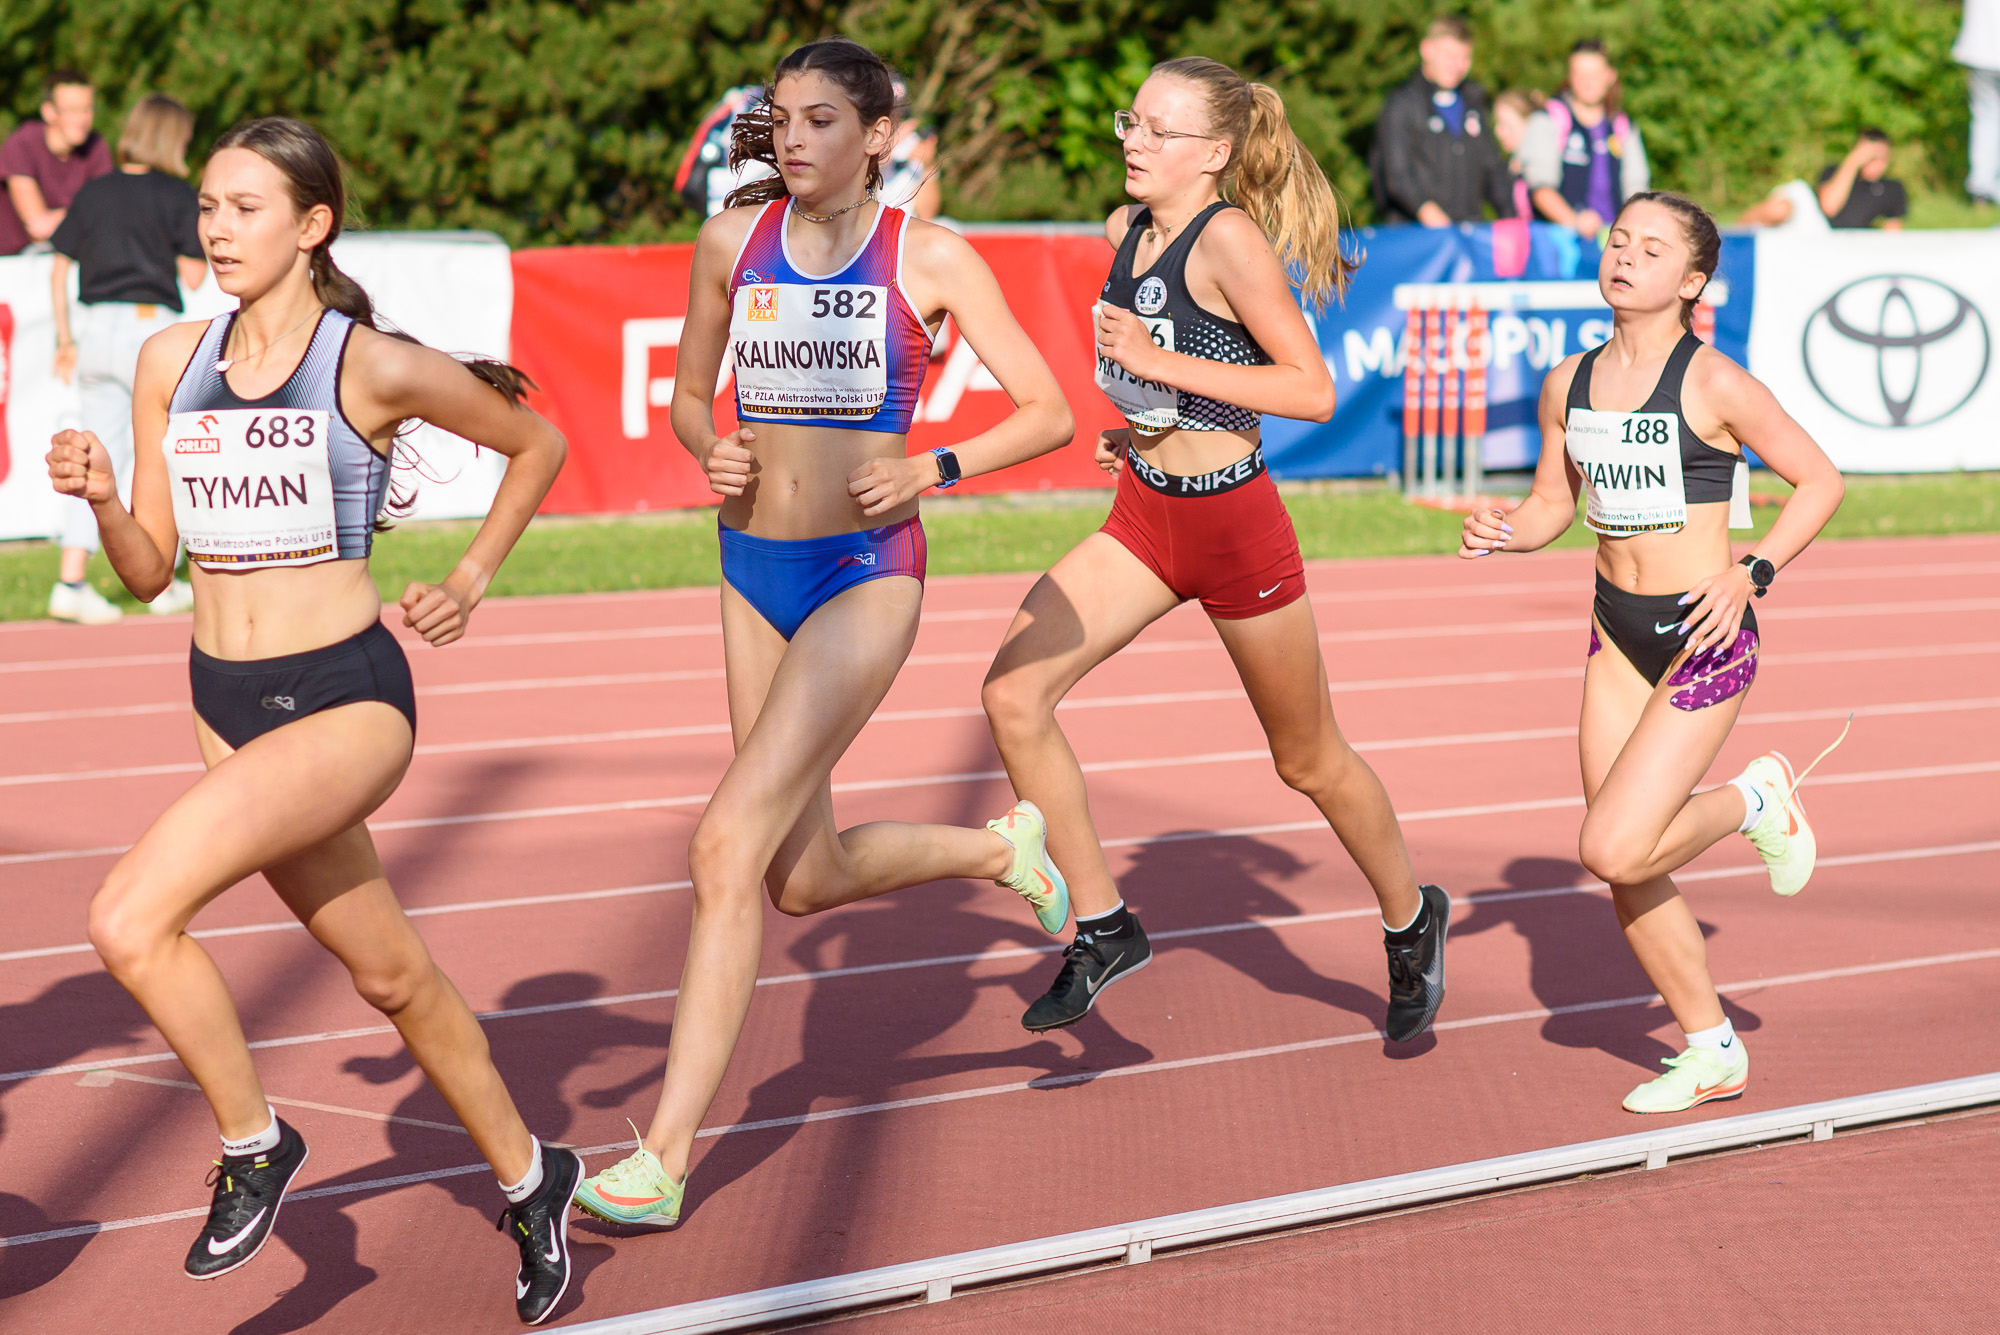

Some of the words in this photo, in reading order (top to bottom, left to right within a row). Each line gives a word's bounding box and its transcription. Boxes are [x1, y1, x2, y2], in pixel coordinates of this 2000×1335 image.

[749, 310, 776, 320] PZLA
[811, 289, 877, 319] 582
[735, 340, 881, 370] KALINOWSKA
[740, 390, 753, 400] 54.
[754, 391, 775, 402] PZLA
[777, 393, 833, 404] Mistrzostwa
[835, 393, 863, 404] Polski
[866, 392, 884, 403] U18
[245, 416, 315, 448] 683
[1621, 418, 1670, 445] 188
[176, 440, 218, 453] ORLEN
[1181, 455, 1253, 493] NIKE
[182, 474, 308, 509] TYMAN
[1636, 510, 1664, 521] Polski
[1666, 509, 1684, 518] U18
[212, 537, 272, 549] Mistrzostwa
[276, 535, 308, 546] Polski
[311, 529, 334, 543] U18
[260, 695, 296, 711] esa
